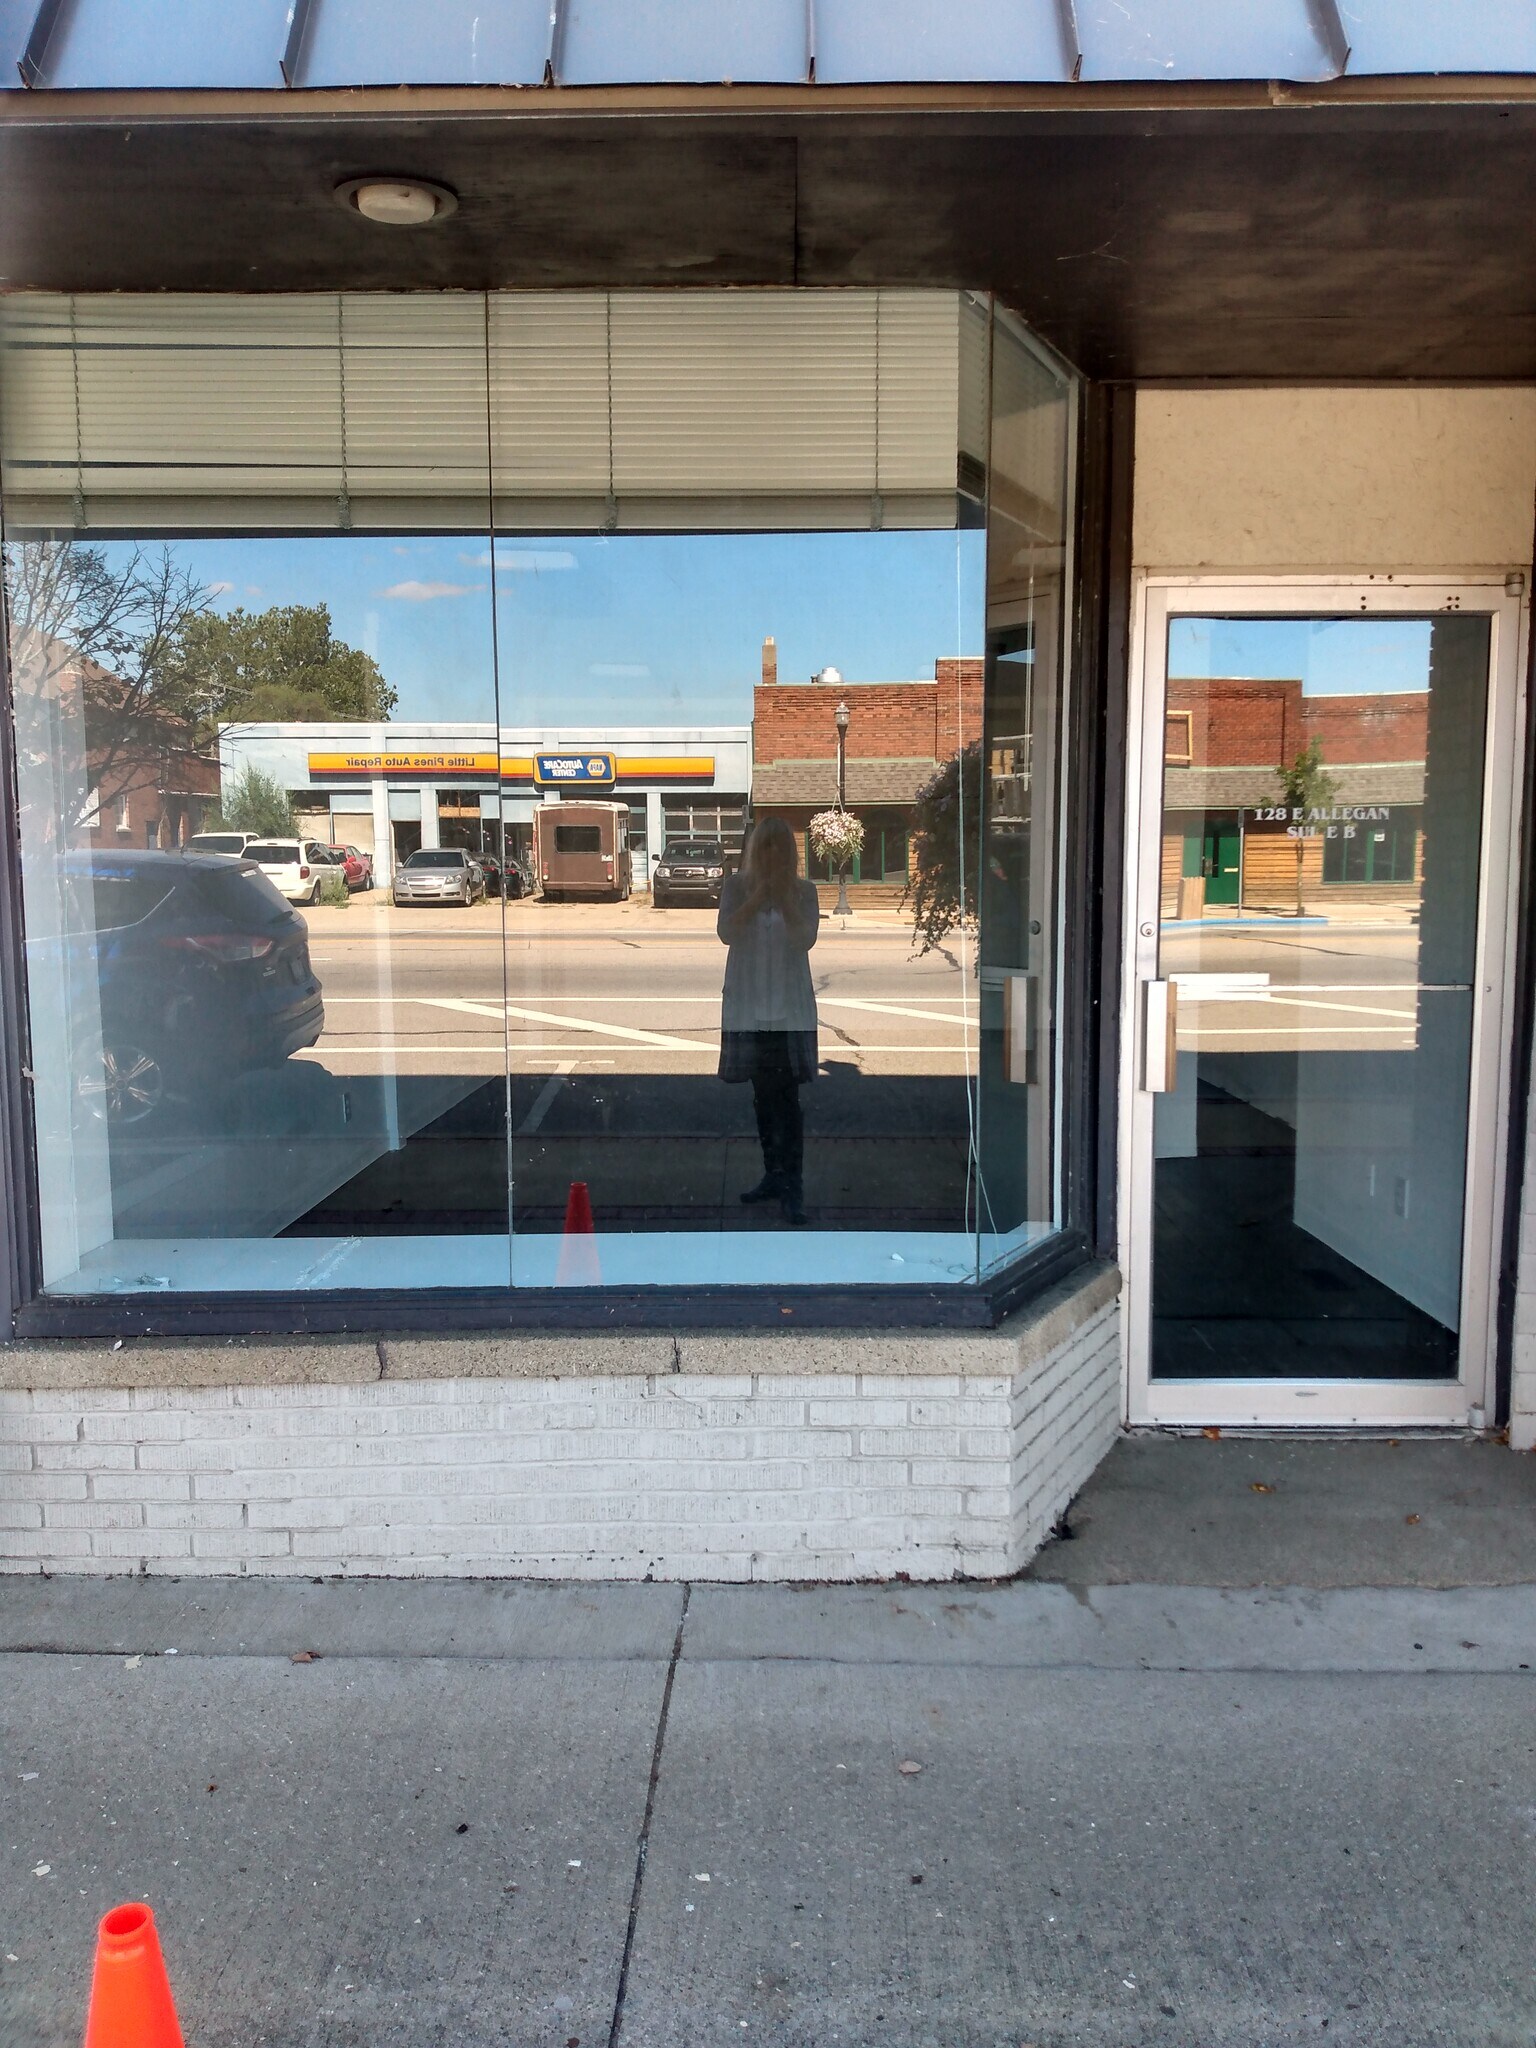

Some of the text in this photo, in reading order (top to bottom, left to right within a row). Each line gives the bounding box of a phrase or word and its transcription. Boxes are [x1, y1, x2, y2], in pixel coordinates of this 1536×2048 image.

[1254, 807, 1390, 821] 128 E ALLEGAN
[1286, 826, 1356, 839] SUIE B
